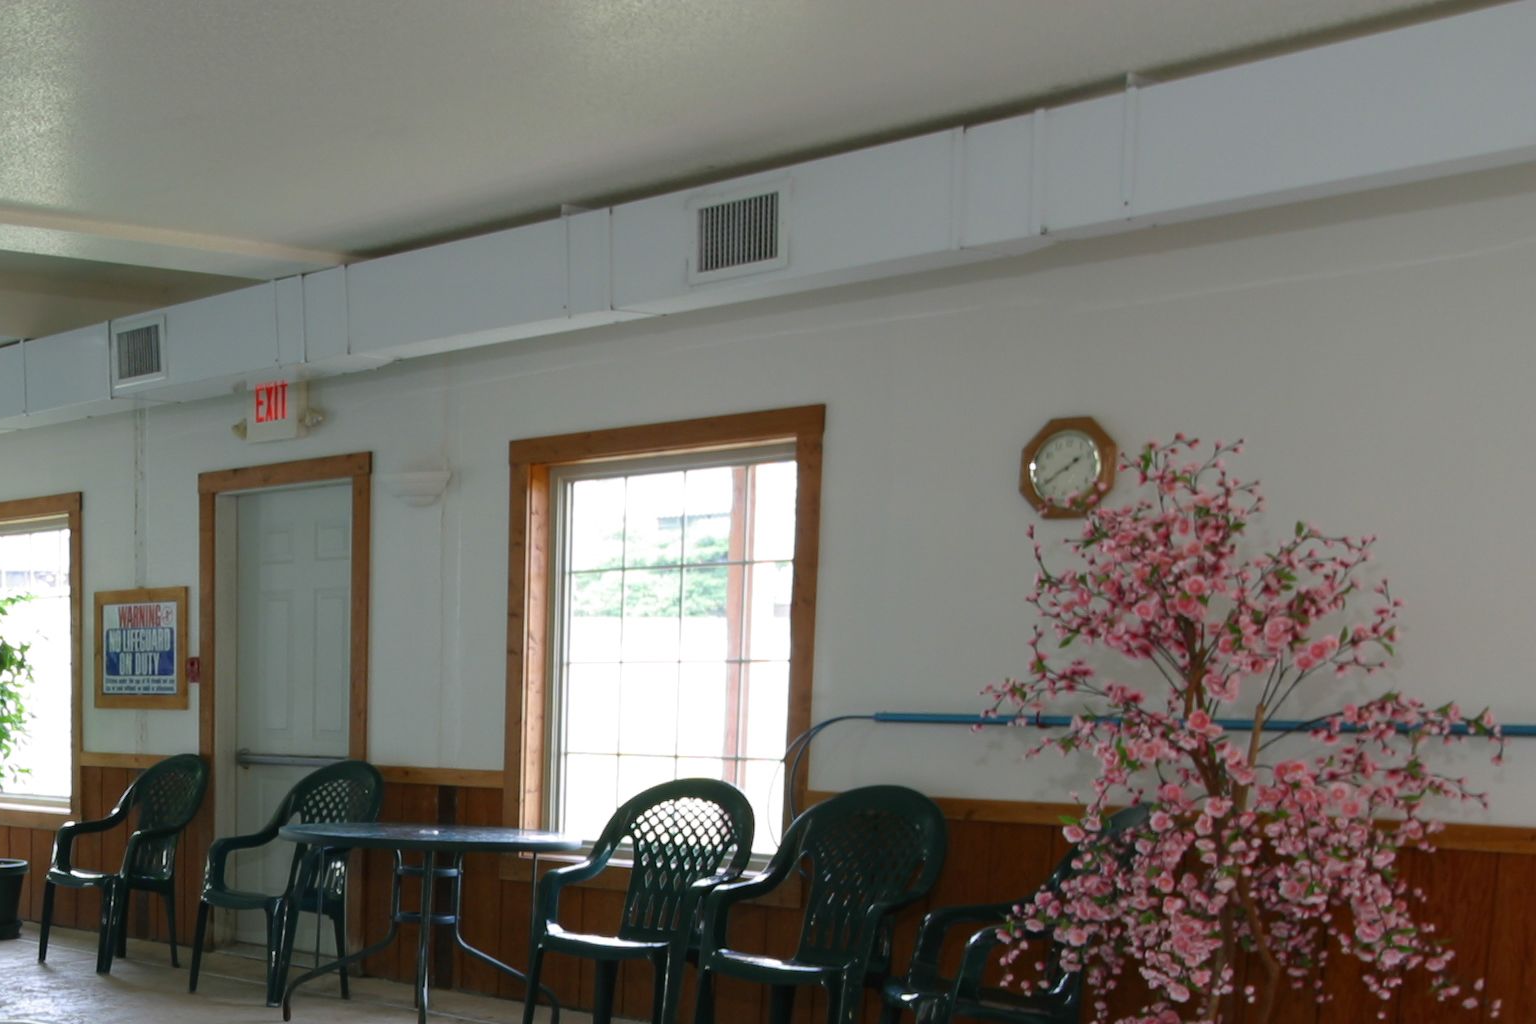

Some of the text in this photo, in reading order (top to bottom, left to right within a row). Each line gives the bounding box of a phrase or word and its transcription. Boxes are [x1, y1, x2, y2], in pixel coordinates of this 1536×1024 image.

[256, 383, 289, 423] EXIT
[119, 605, 161, 628] WARNING
[109, 628, 171, 652] NO LIFEGUARD
[120, 652, 160, 675] ON DUTY
